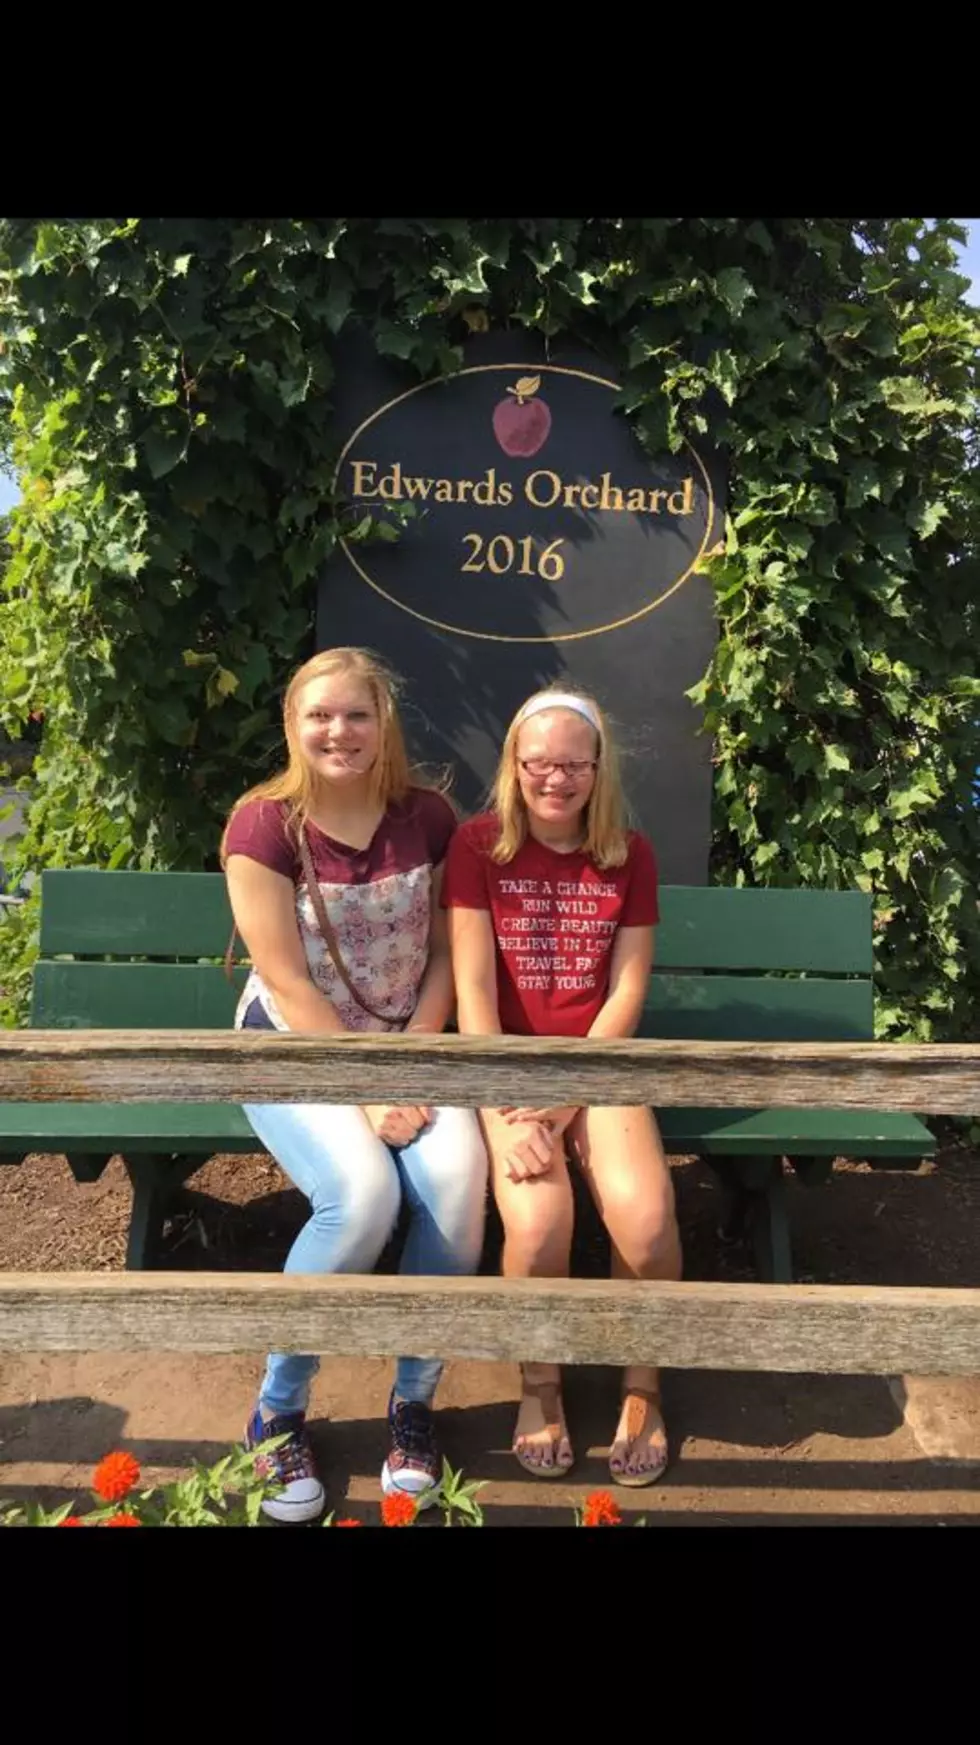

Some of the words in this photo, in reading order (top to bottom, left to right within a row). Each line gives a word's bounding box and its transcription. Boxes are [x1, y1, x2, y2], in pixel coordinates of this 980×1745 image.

[350, 461, 512, 505] Edwards
[524, 469, 694, 515] Orchard
[460, 533, 566, 581] 2016
[498, 880, 537, 893] TAKE
[542, 881, 552, 894] A
[557, 882, 617, 896] CHANCE
[522, 899, 550, 912] RUN
[556, 901, 597, 915] WILD
[501, 918, 555, 931] CREATE
[560, 919, 618, 934] BEAUTY
[498, 936, 558, 950] BELIEVE
[564, 938, 580, 951] IN
[516, 956, 571, 970] TRAVEL
[518, 976, 550, 989] STAY
